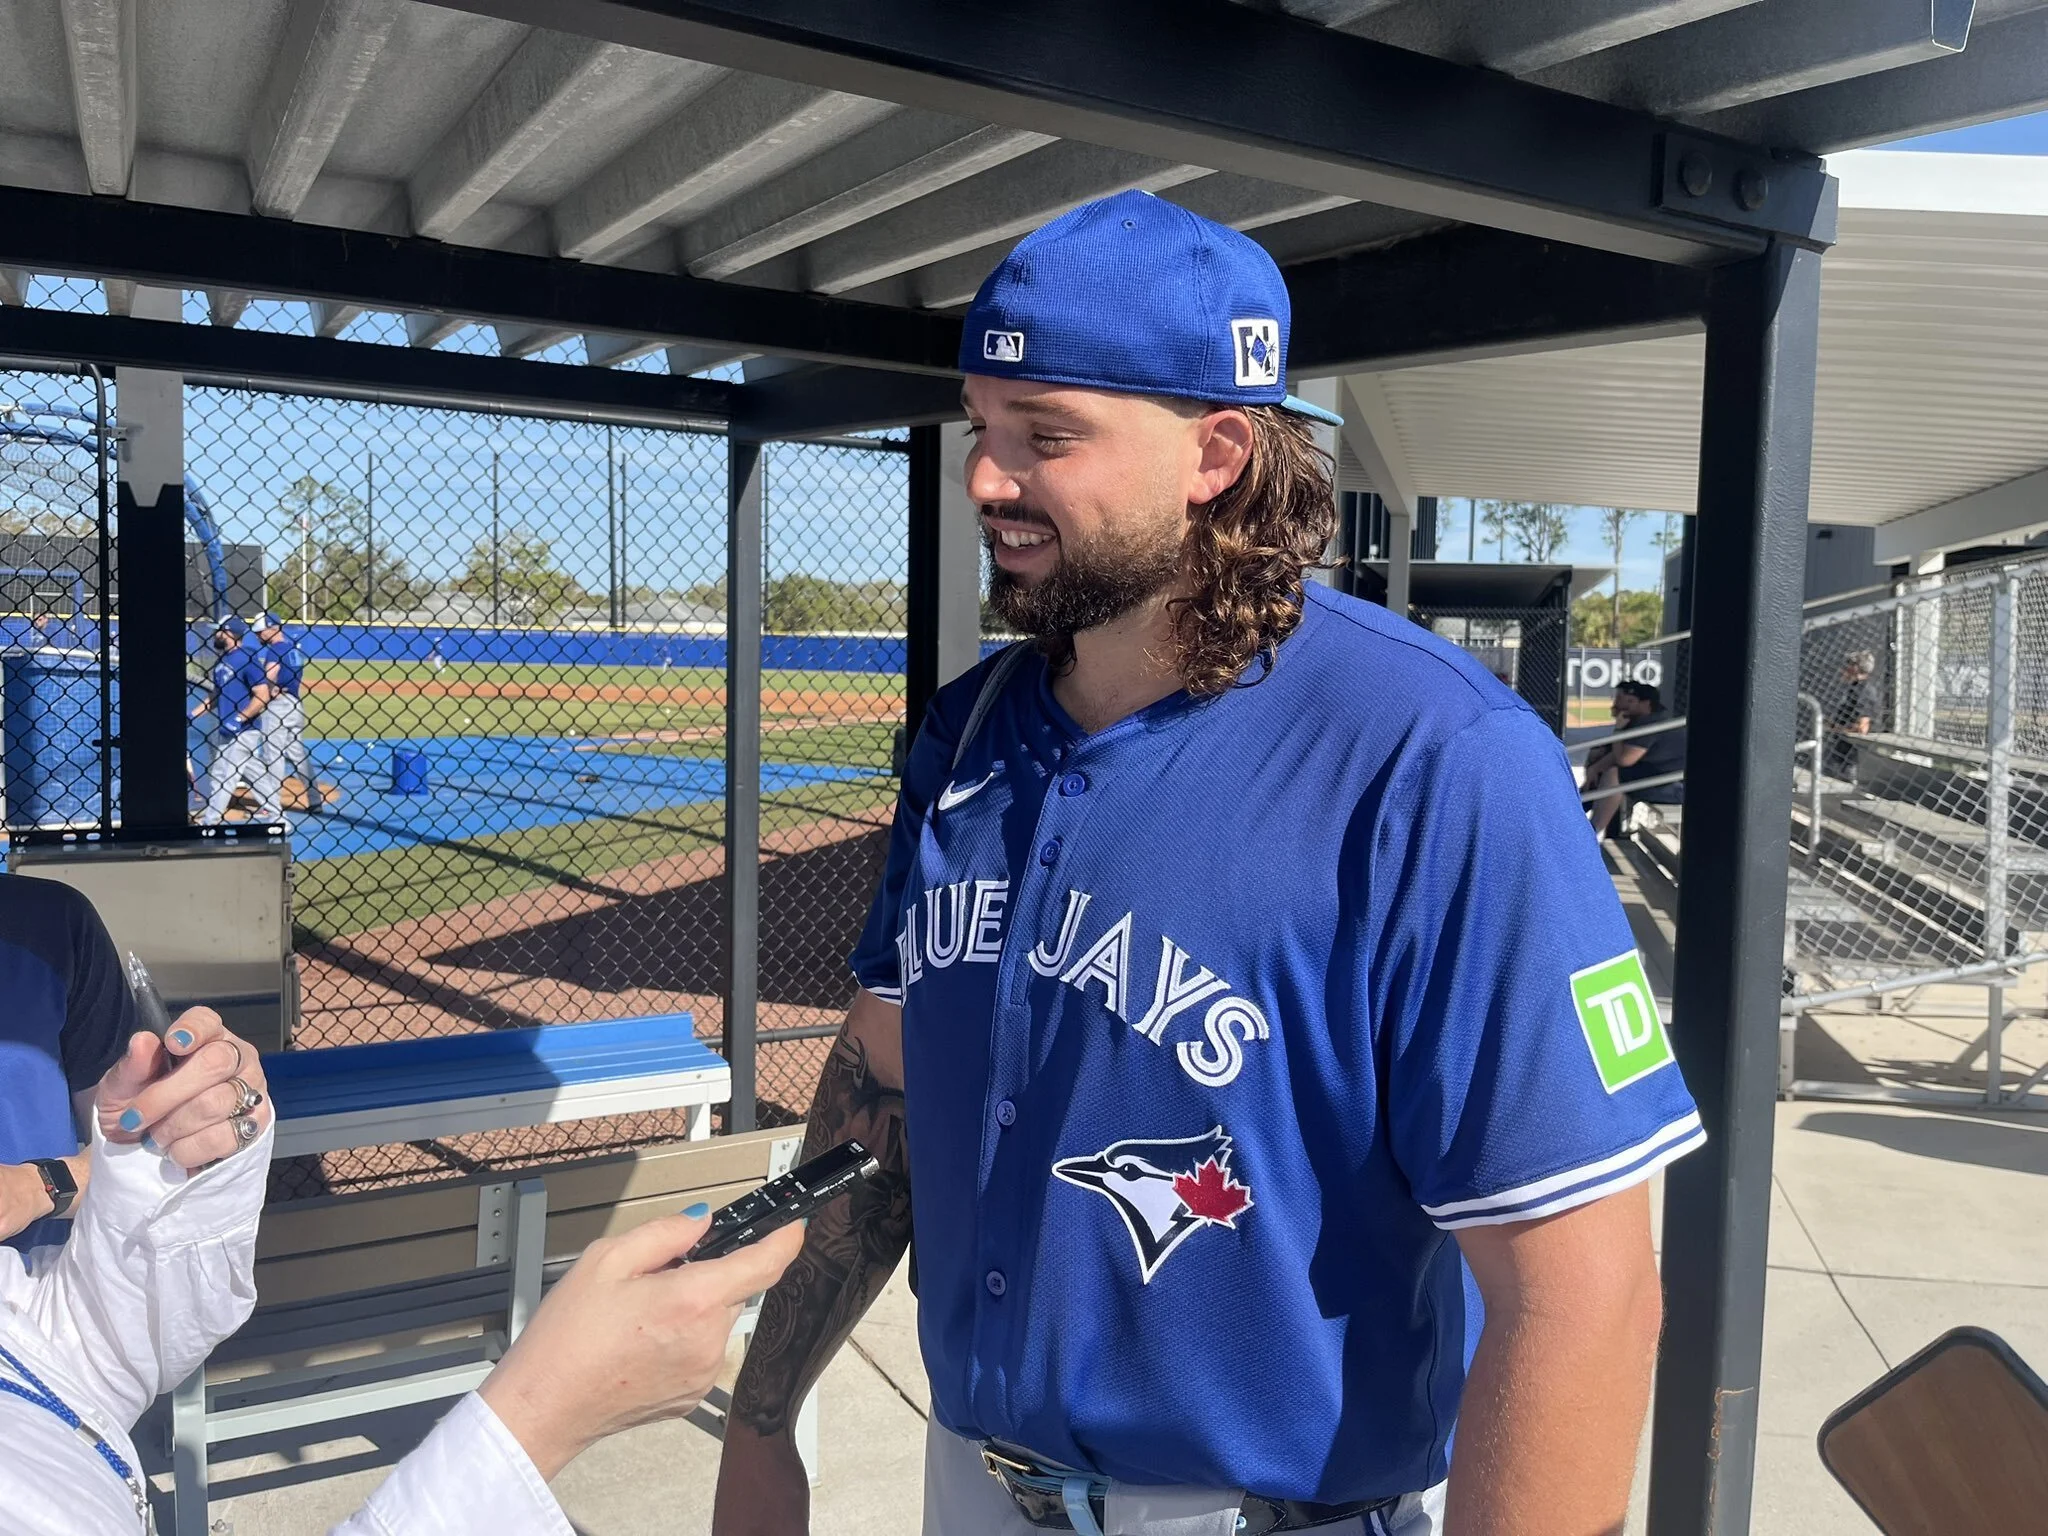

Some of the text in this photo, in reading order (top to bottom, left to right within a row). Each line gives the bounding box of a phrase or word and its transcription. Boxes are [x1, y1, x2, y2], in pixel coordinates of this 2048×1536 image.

[1027, 889, 1270, 1088] JAYS
[1585, 981, 1653, 1057] TD
[813, 1186, 830, 1198] POWER
[842, 1171, 856, 1182] HOLD
